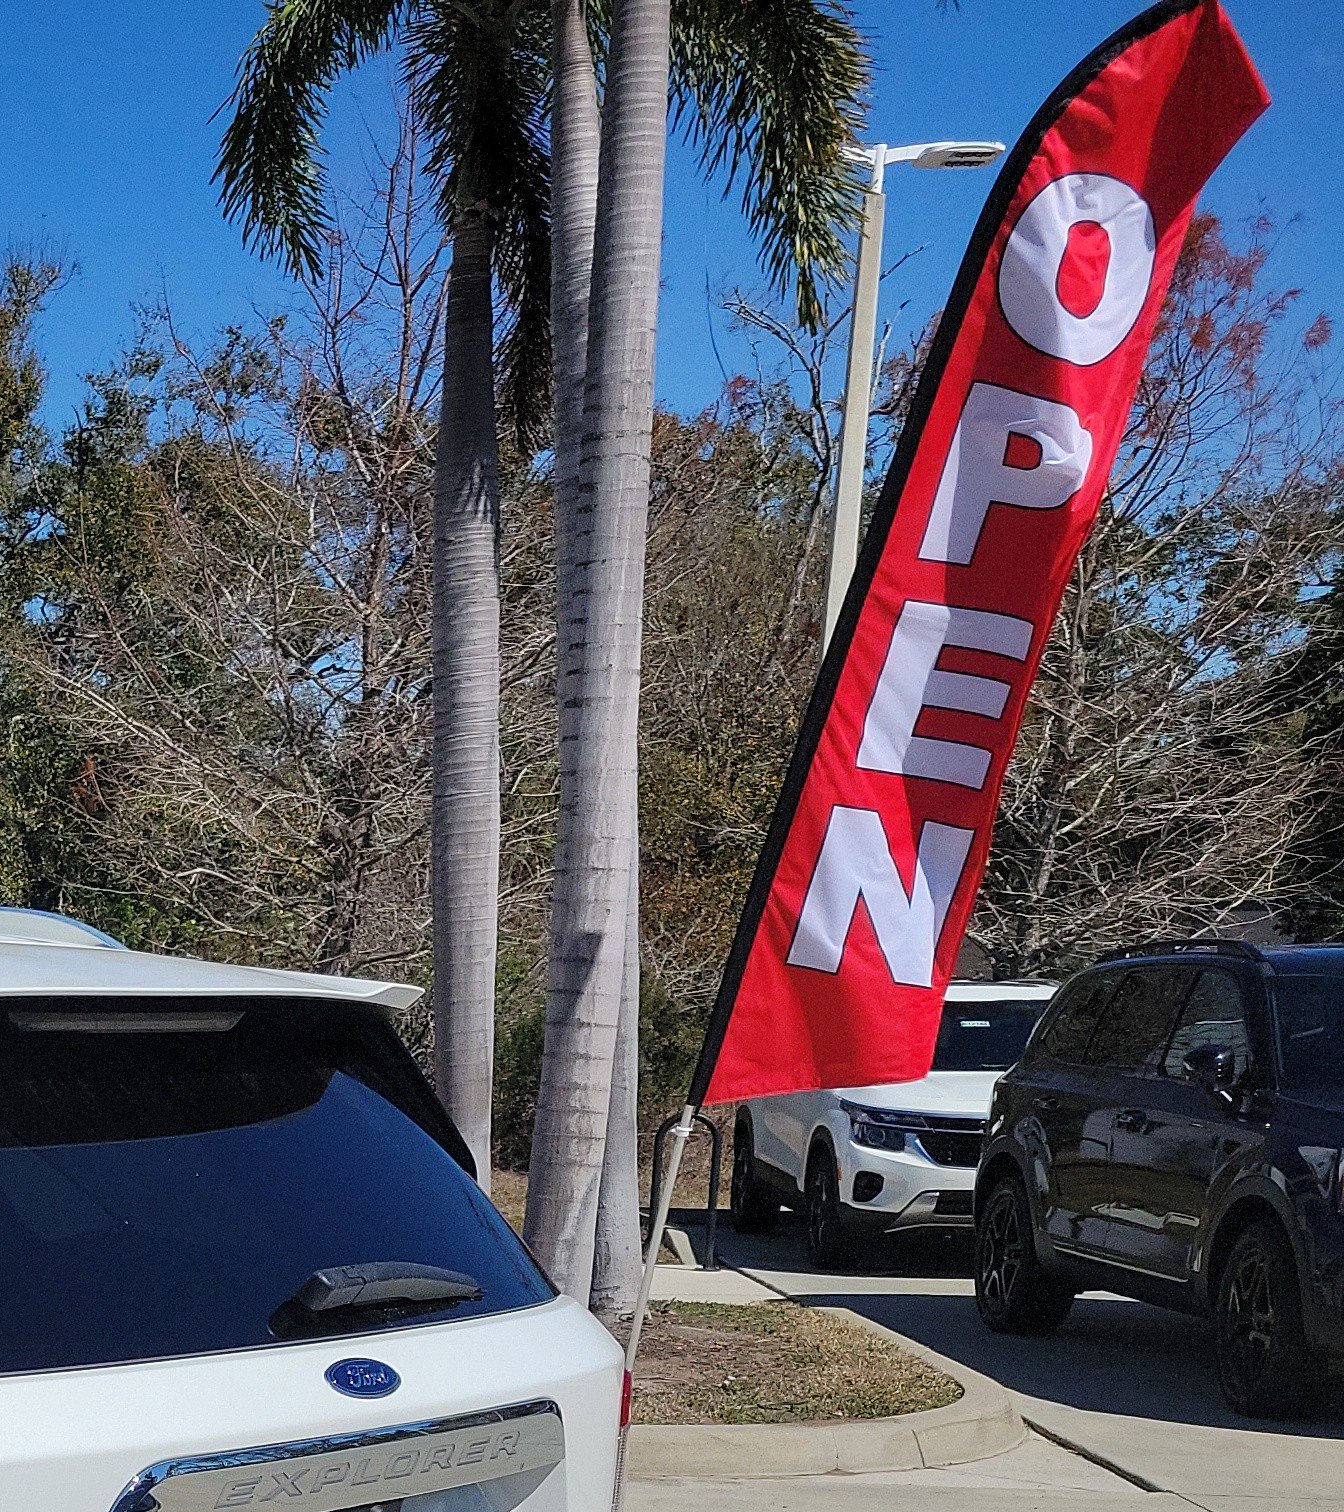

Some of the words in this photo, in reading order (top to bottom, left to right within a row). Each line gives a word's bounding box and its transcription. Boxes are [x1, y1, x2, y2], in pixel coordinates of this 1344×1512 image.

[785, 172, 1155, 988] OPEN
[346, 1363, 390, 1389] Ford
[214, 1430, 521, 1510] EXPLORER
